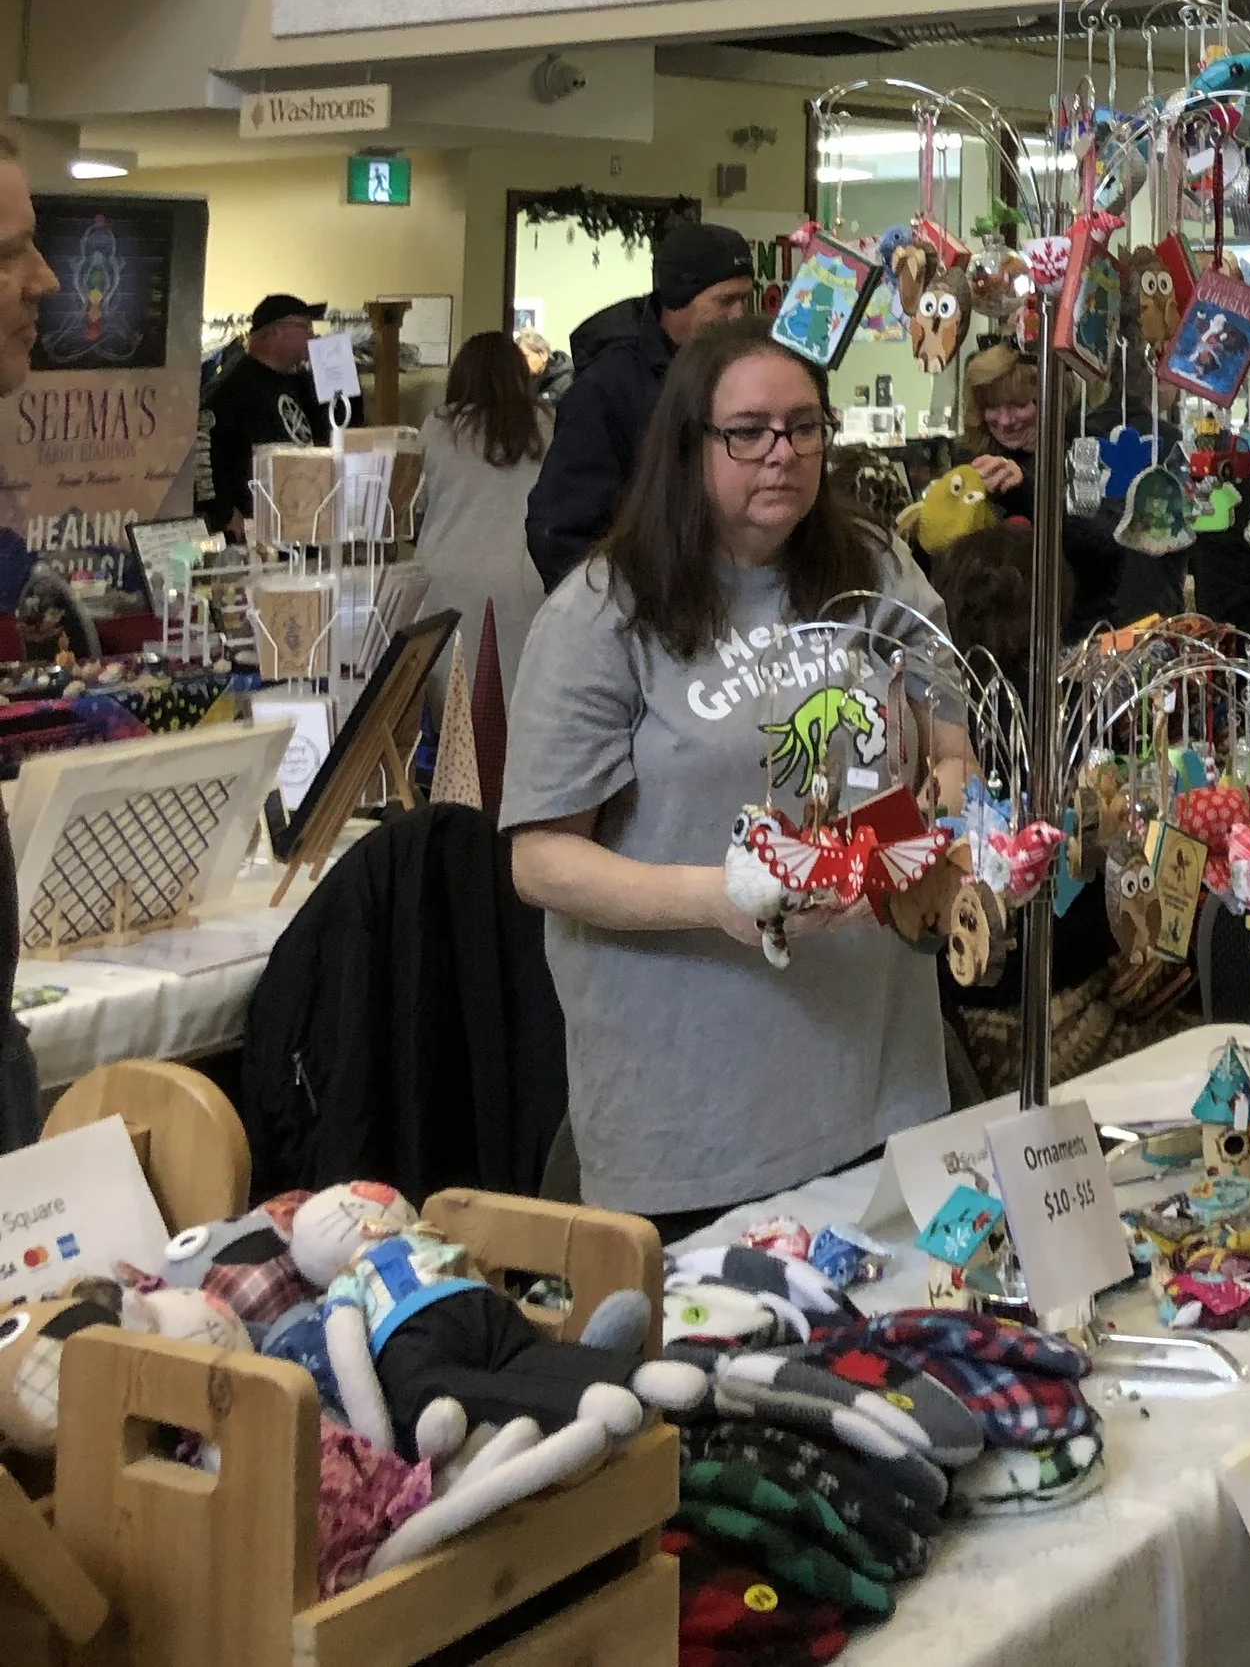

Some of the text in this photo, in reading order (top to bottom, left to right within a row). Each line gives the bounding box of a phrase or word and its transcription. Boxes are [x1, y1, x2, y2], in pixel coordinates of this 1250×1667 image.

[270, 96, 376, 123] Washrooms
[16, 385, 157, 446] SEEMA'S
[715, 623, 832, 669] Merry
[1023, 1135, 1088, 1171] Ornaments
[2, 1197, 66, 1233] Square
